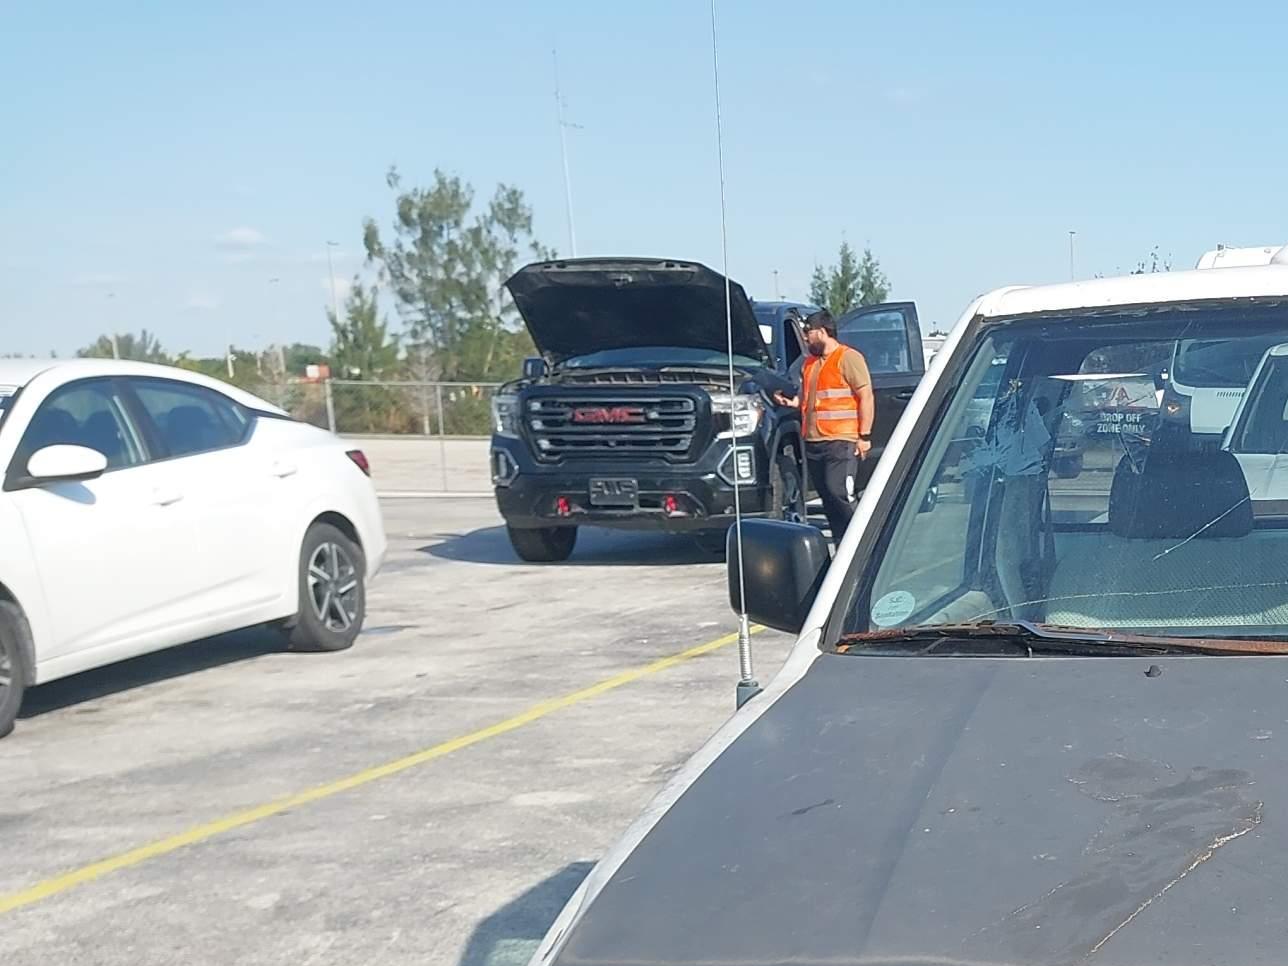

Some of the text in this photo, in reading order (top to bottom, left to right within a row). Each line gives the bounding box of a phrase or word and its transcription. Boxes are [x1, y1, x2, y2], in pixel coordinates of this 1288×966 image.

[1101, 413, 1143, 423] DROP OFF
[1096, 423, 1146, 433] ZONE ONLY
